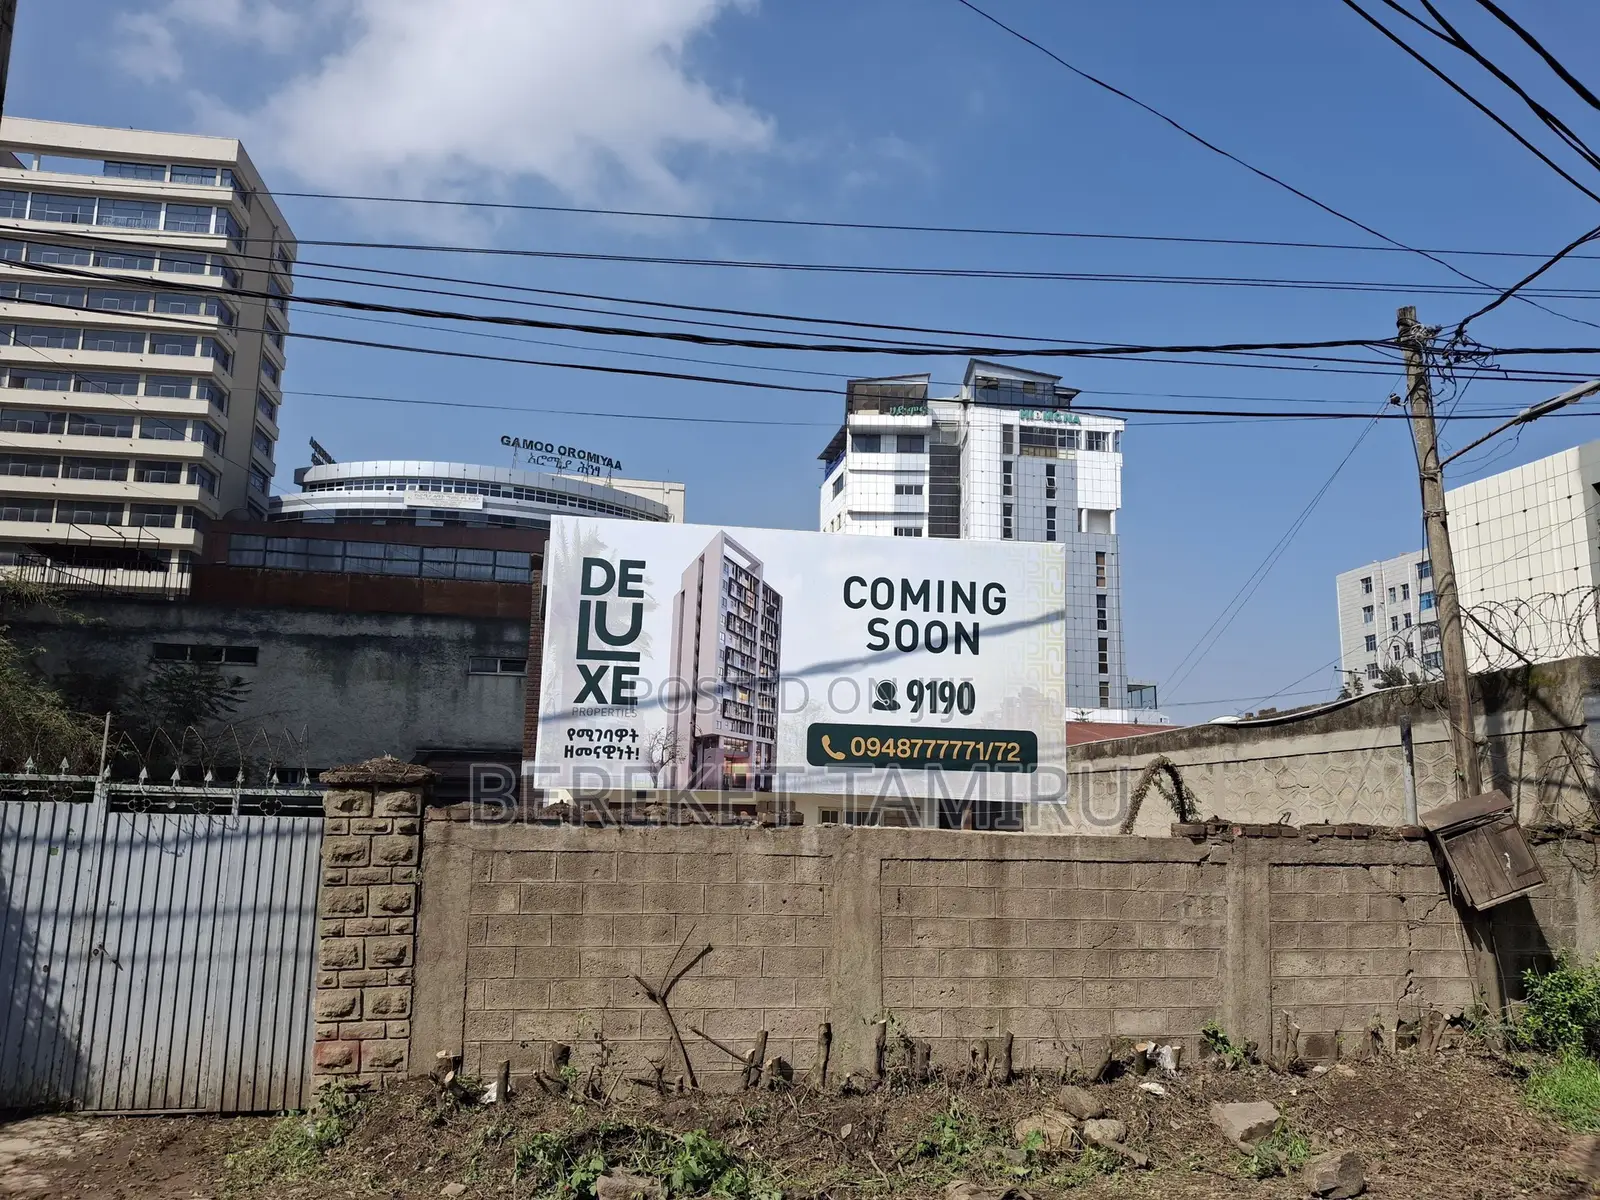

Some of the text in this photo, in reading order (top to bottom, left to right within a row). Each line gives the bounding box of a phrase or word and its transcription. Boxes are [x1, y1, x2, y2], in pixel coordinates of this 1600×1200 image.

[500, 435, 622, 471] GAMOO OROMIYAA
[843, 575, 1007, 616] COMING
[866, 617, 980, 656] SOON
[572, 706, 638, 718] PROPERTIES
[906, 678, 977, 716] 9190
[850, 736, 1021, 762] 0948777771/72
